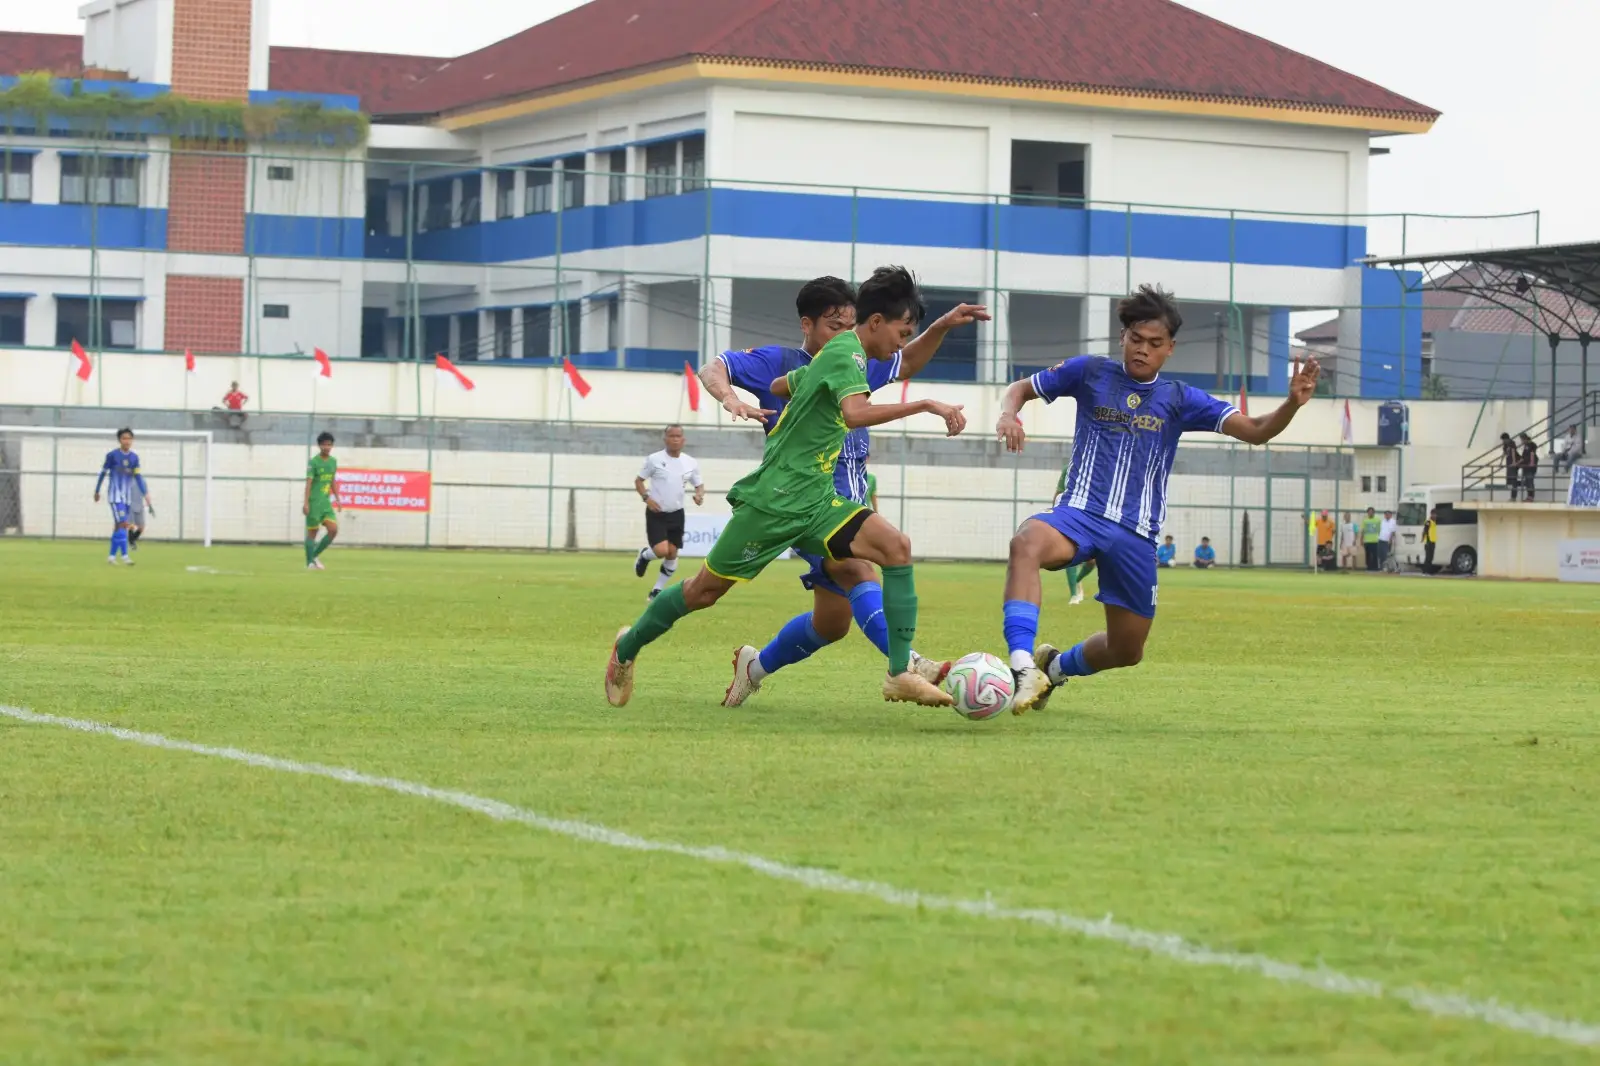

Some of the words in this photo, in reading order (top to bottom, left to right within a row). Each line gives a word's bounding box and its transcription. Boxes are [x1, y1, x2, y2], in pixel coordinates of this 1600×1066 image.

[383, 474, 406, 484] ERA
[339, 484, 402, 495] KEEMASAN
[354, 495, 385, 505] BOLA
[388, 497, 426, 507] DEPOK
